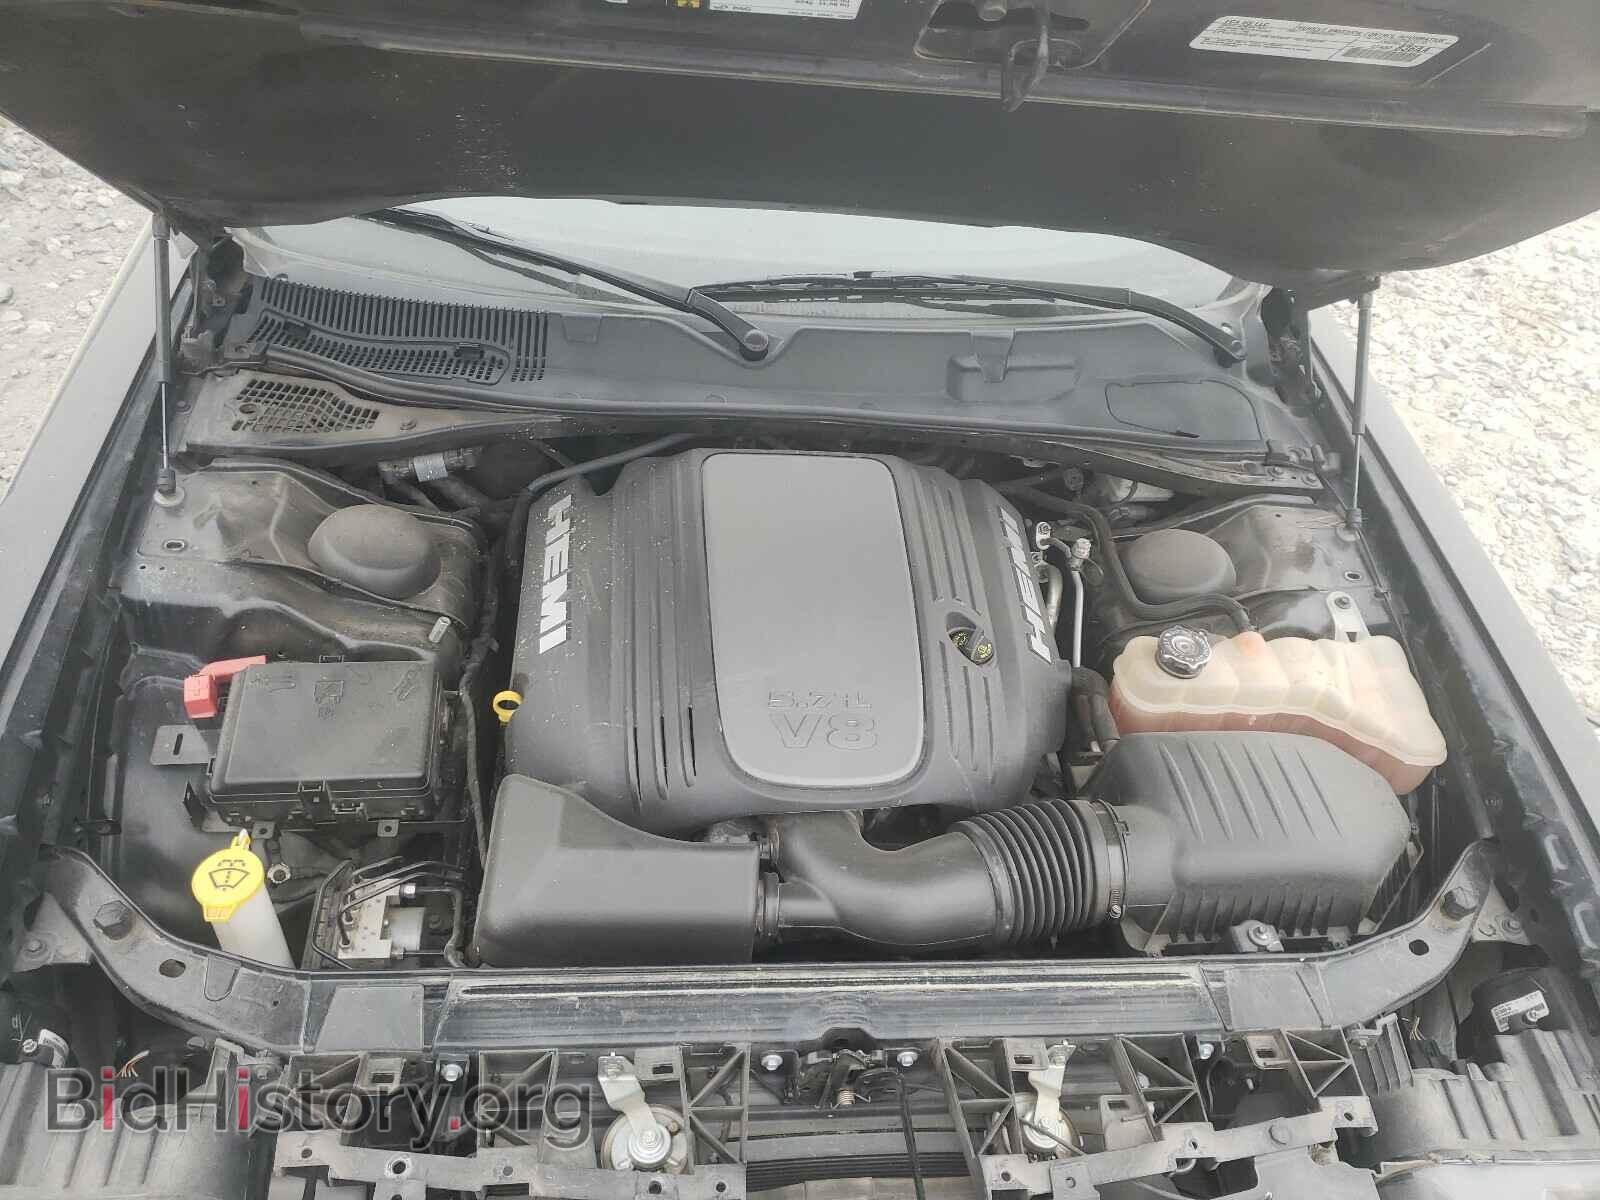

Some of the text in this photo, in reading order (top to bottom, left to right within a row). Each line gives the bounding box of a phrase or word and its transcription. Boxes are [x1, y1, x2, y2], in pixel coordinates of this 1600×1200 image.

[539, 494, 573, 655] HEMI
[1000, 506, 1052, 664] HEMI
[768, 713, 880, 751] V8
